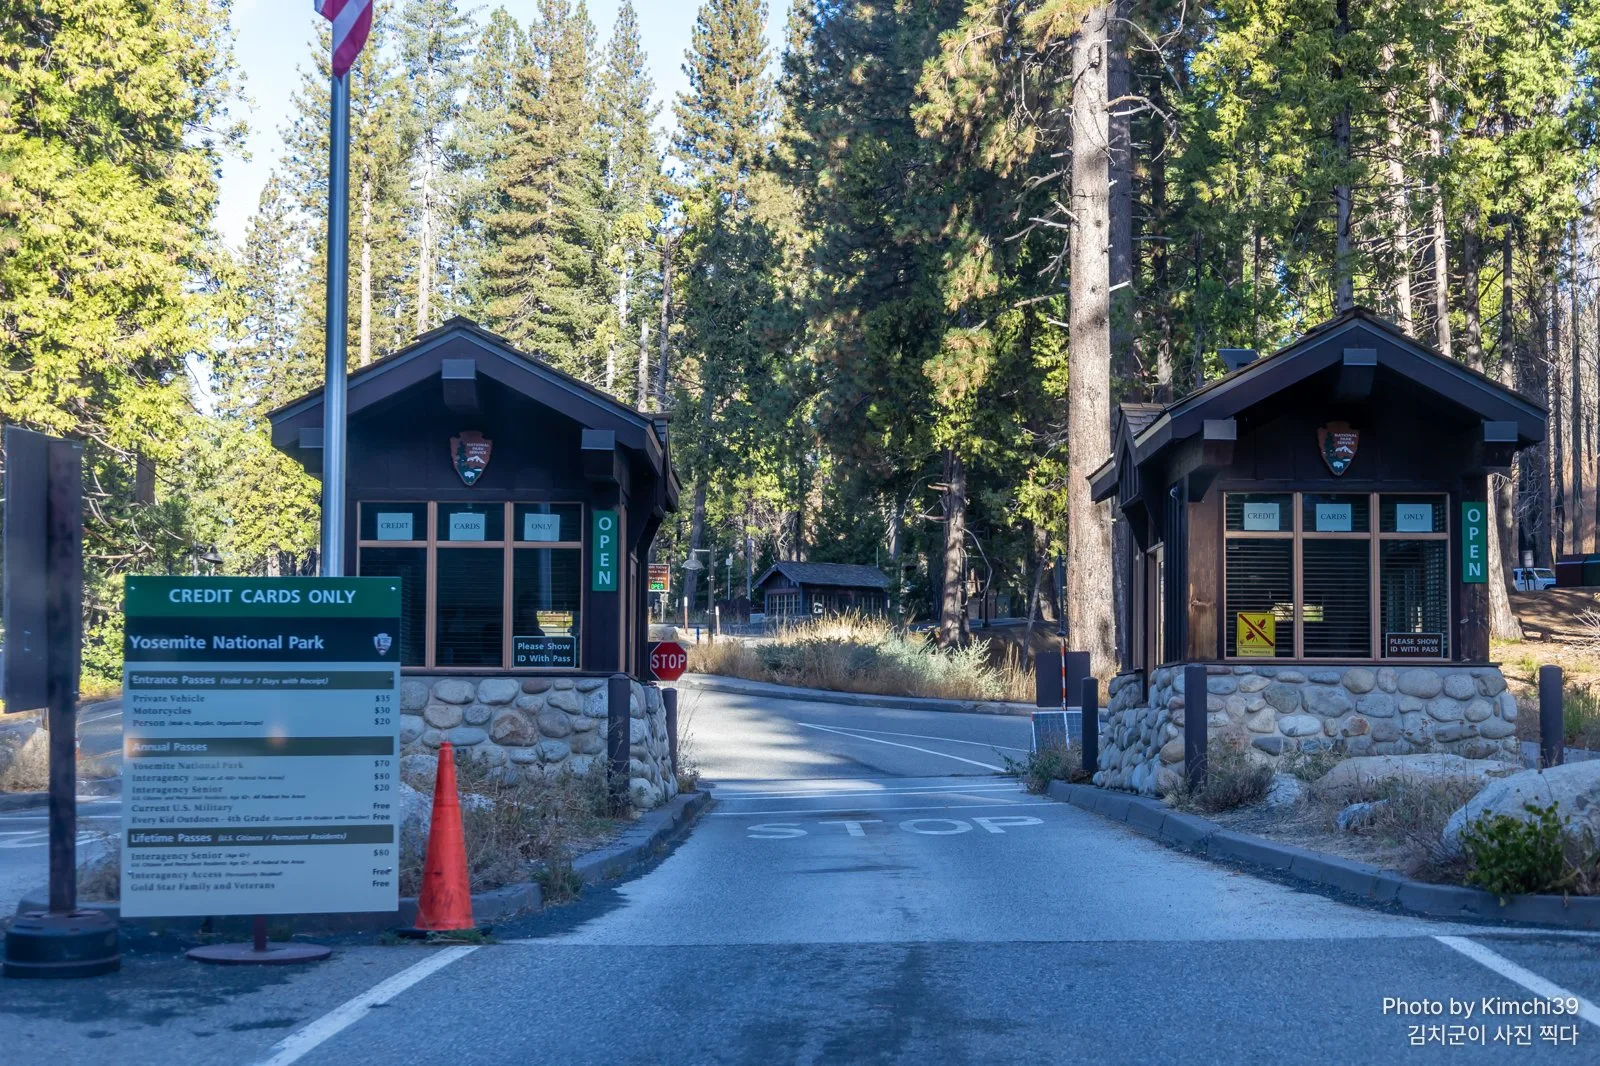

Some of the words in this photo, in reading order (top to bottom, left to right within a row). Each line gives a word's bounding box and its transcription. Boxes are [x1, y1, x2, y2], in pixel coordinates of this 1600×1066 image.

[1248, 512, 1276, 520] CREDIT
[1467, 508, 1481, 578] OPEN
[598, 517, 612, 586] OPEN
[168, 588, 233, 603] CREDIT
[240, 589, 301, 604] CARDS
[308, 589, 357, 604] ONLY
[129, 635, 206, 649] Yosemite
[212, 635, 283, 649] National
[288, 635, 325, 649] Park
[517, 642, 544, 650] Please
[547, 642, 571, 650] Show
[652, 654, 686, 669] STOP
[132, 675, 178, 685] Entrance
[182, 675, 216, 685] Passes
[133, 694, 168, 703] Private
[170, 694, 206, 703] Vehicle
[375, 694, 390, 703] $35
[133, 706, 192, 717] Motorcycles
[374, 705, 391, 714] $30
[374, 717, 391, 725] $20
[133, 742, 170, 752] Annual
[173, 743, 208, 752] Passes
[178, 762, 220, 770] National
[222, 761, 244, 769] Park
[374, 759, 390, 767] $70
[132, 774, 189, 784] Interagency
[132, 786, 189, 796] Interagency
[191, 785, 224, 794] Senior
[374, 784, 390, 792] $20
[131, 804, 170, 812] Current
[172, 804, 191, 812] U.S.
[194, 803, 233, 813] Military
[131, 815, 157, 825] Every
[159, 815, 175, 824] Kid
[177, 815, 219, 823] Outdoors
[227, 814, 241, 822] 4th
[243, 813, 270, 822] Grade
[372, 813, 391, 821] Free
[747, 815, 1045, 840] STOP
[131, 833, 174, 843] Lifetime
[178, 833, 212, 842] Passes
[131, 853, 188, 862] Interagency
[191, 852, 223, 860] Senior
[373, 848, 389, 857] $80
[131, 871, 188, 881] Interagency
[192, 871, 223, 879] Access
[372, 868, 391, 876] Free
[130, 883, 154, 892] Gold
[156, 883, 176, 891] Star
[178, 882, 211, 893] Family
[213, 883, 232, 891] and
[234, 881, 275, 890] Veterans
[372, 880, 390, 888] Free
